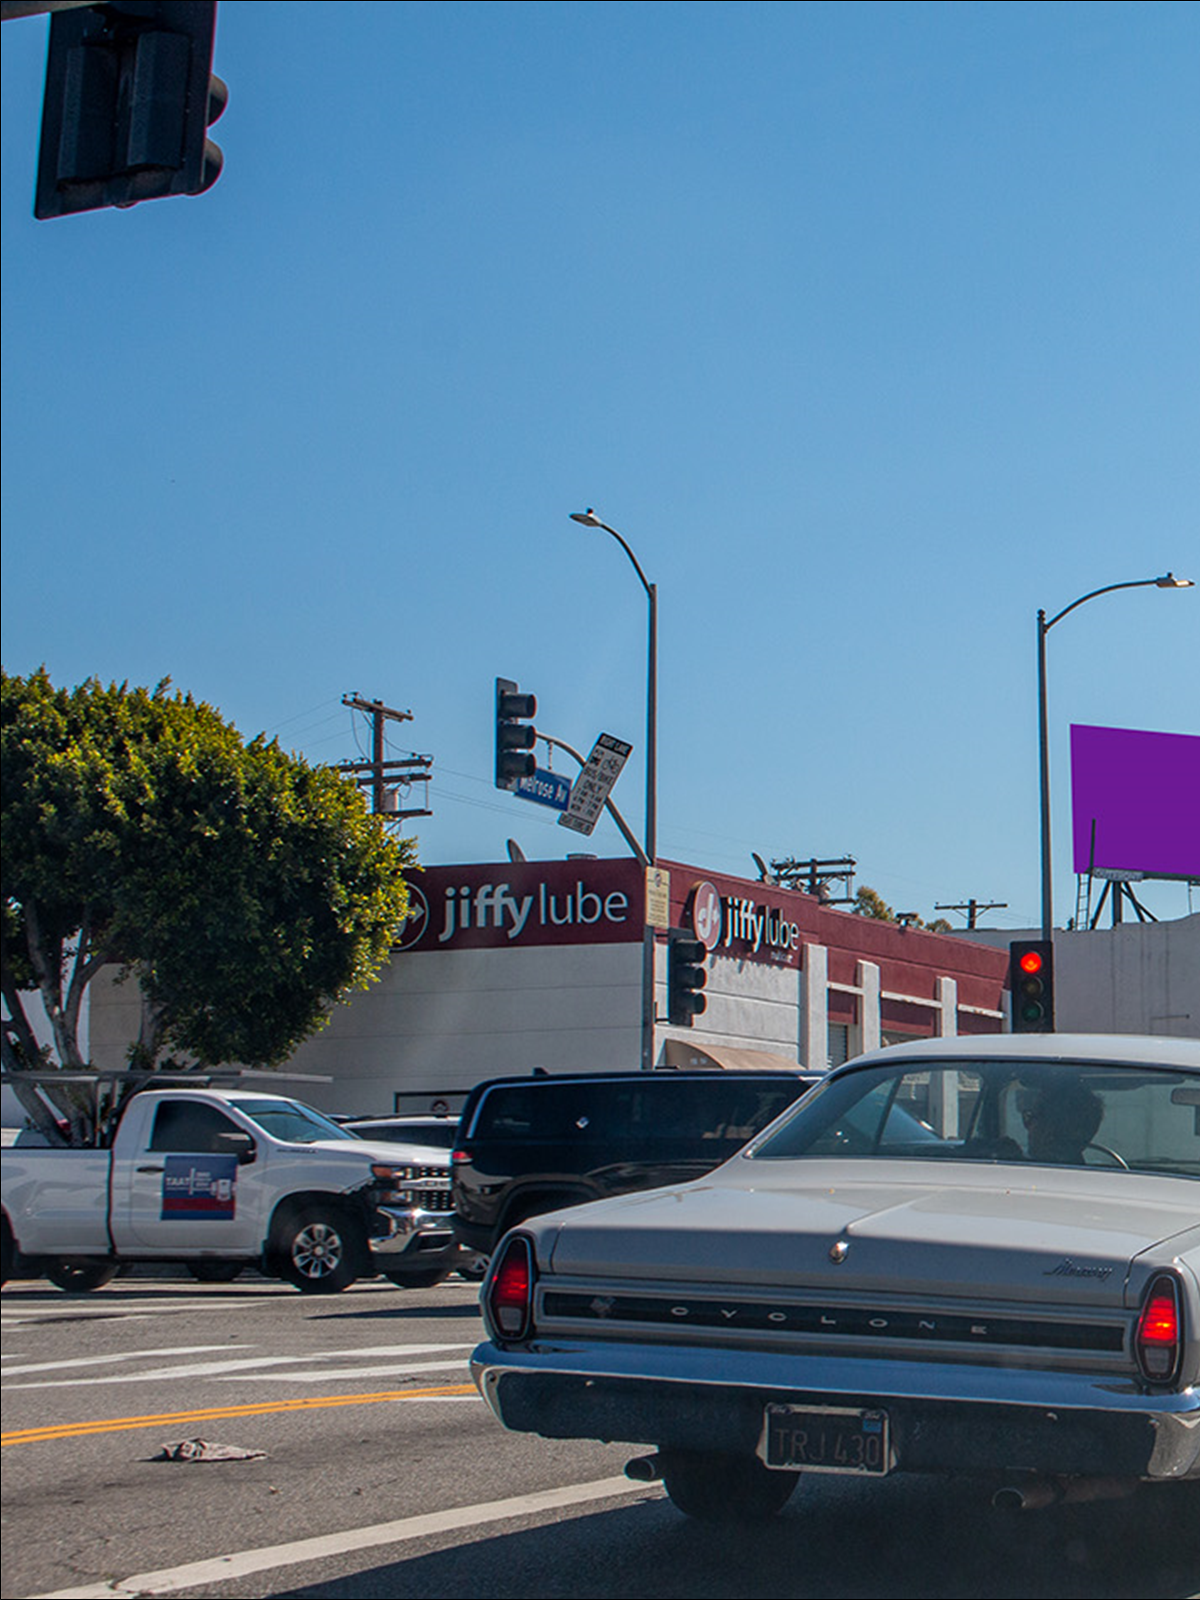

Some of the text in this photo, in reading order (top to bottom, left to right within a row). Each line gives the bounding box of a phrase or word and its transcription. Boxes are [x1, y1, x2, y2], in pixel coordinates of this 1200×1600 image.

[519, 776, 568, 803] Melrose Av
[438, 884, 533, 942] jiffy
[540, 881, 629, 925] lube
[724, 896, 764, 953] jiffy
[765, 904, 800, 950] lube
[670, 1305, 988, 1335] CYCLONE
[774, 1428, 881, 1466] TRJ 430
